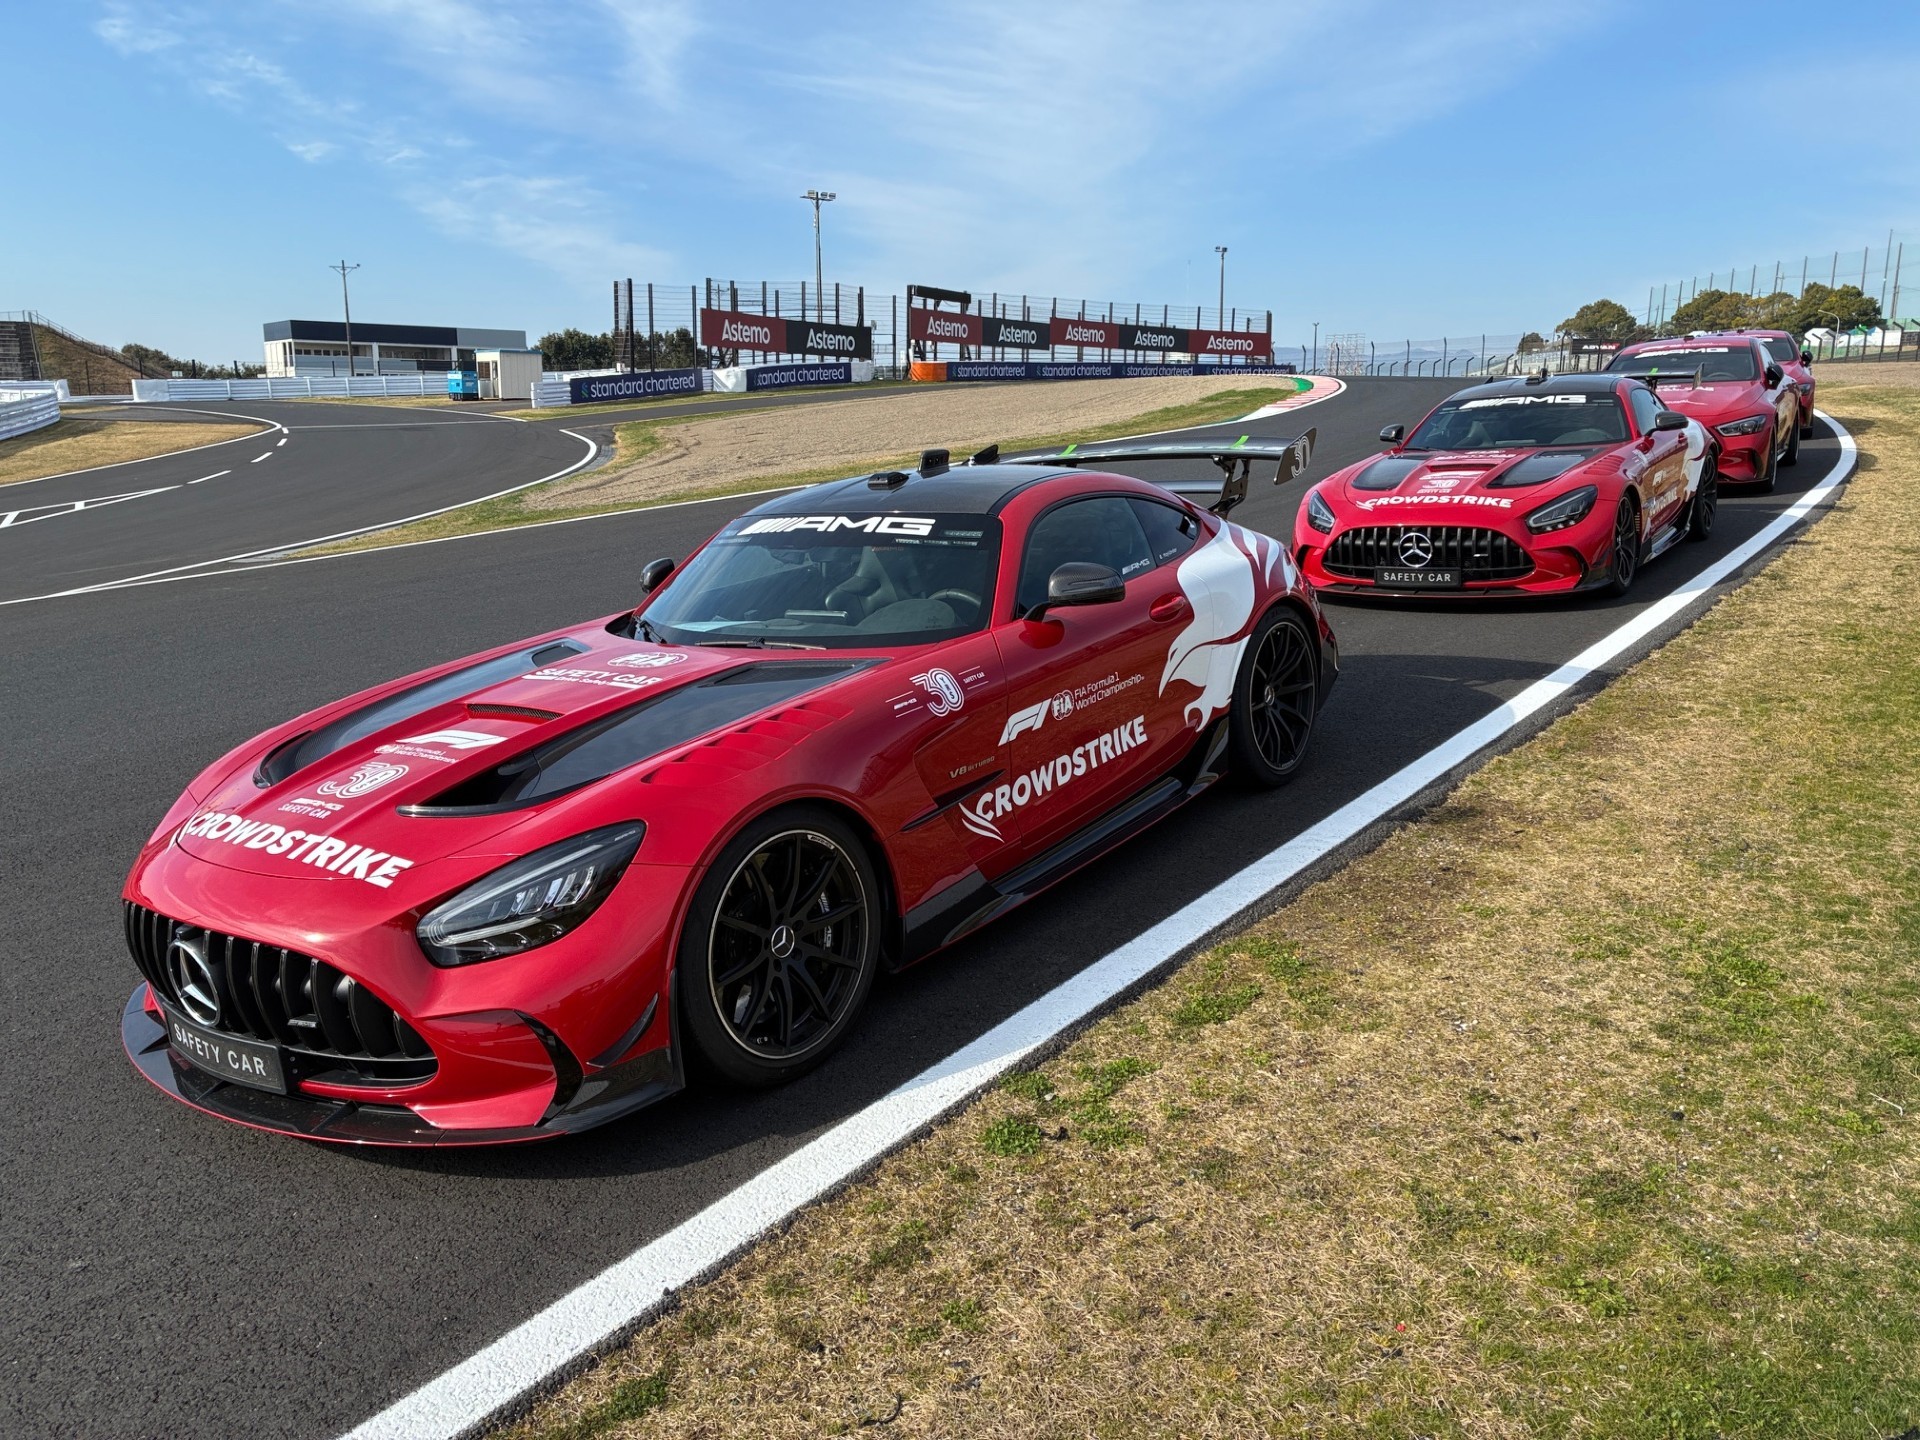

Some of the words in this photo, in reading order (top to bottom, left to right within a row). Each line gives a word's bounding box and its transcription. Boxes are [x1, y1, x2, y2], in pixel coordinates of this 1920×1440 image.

[722, 318, 770, 344] Astemo
[926, 316, 968, 338] Astemo
[998, 324, 1037, 344] Astemo
[1065, 324, 1105, 343] Astemo
[806, 328, 856, 351] Astemo
[1134, 330, 1174, 348] Astemo
[1207, 335, 1253, 351] Astemo
[757, 368, 796, 386] standard
[797, 366, 845, 382] chartered
[957, 365, 989, 378] standard
[989, 365, 1025, 377] chartered
[1041, 364, 1075, 377] standard
[1076, 364, 1111, 376] chartered
[1126, 365, 1157, 377] standard
[1158, 366, 1193, 377] chartered
[590, 377, 644, 398] standard
[645, 373, 695, 392] chartered
[1497, 394, 1587, 405] AMG
[1289, 435, 1310, 478] 30
[1366, 494, 1514, 509] CROWDSTRIKE
[789, 516, 936, 536] AMG
[1383, 572, 1424, 582] SAFETY
[1428, 572, 1451, 582] CAR
[536, 668, 616, 679] SAFETY
[612, 674, 664, 686] CAR
[1074, 687, 1087, 700] FIA
[1086, 674, 1115, 694] Formula
[1114, 671, 1120, 681] 1
[909, 668, 965, 717] 30
[1074, 692, 1097, 710] World
[997, 698, 1052, 747] F1
[949, 765, 967, 778] V8
[976, 715, 1148, 822] CROWDSTRIKE
[317, 761, 409, 798] 30
[278, 803, 314, 815] SAFETY
[308, 808, 332, 820] CAR
[186, 812, 415, 889] CROWDSTRIKE
[174, 1023, 220, 1063] SAFETY
[227, 1050, 267, 1076] CAR
